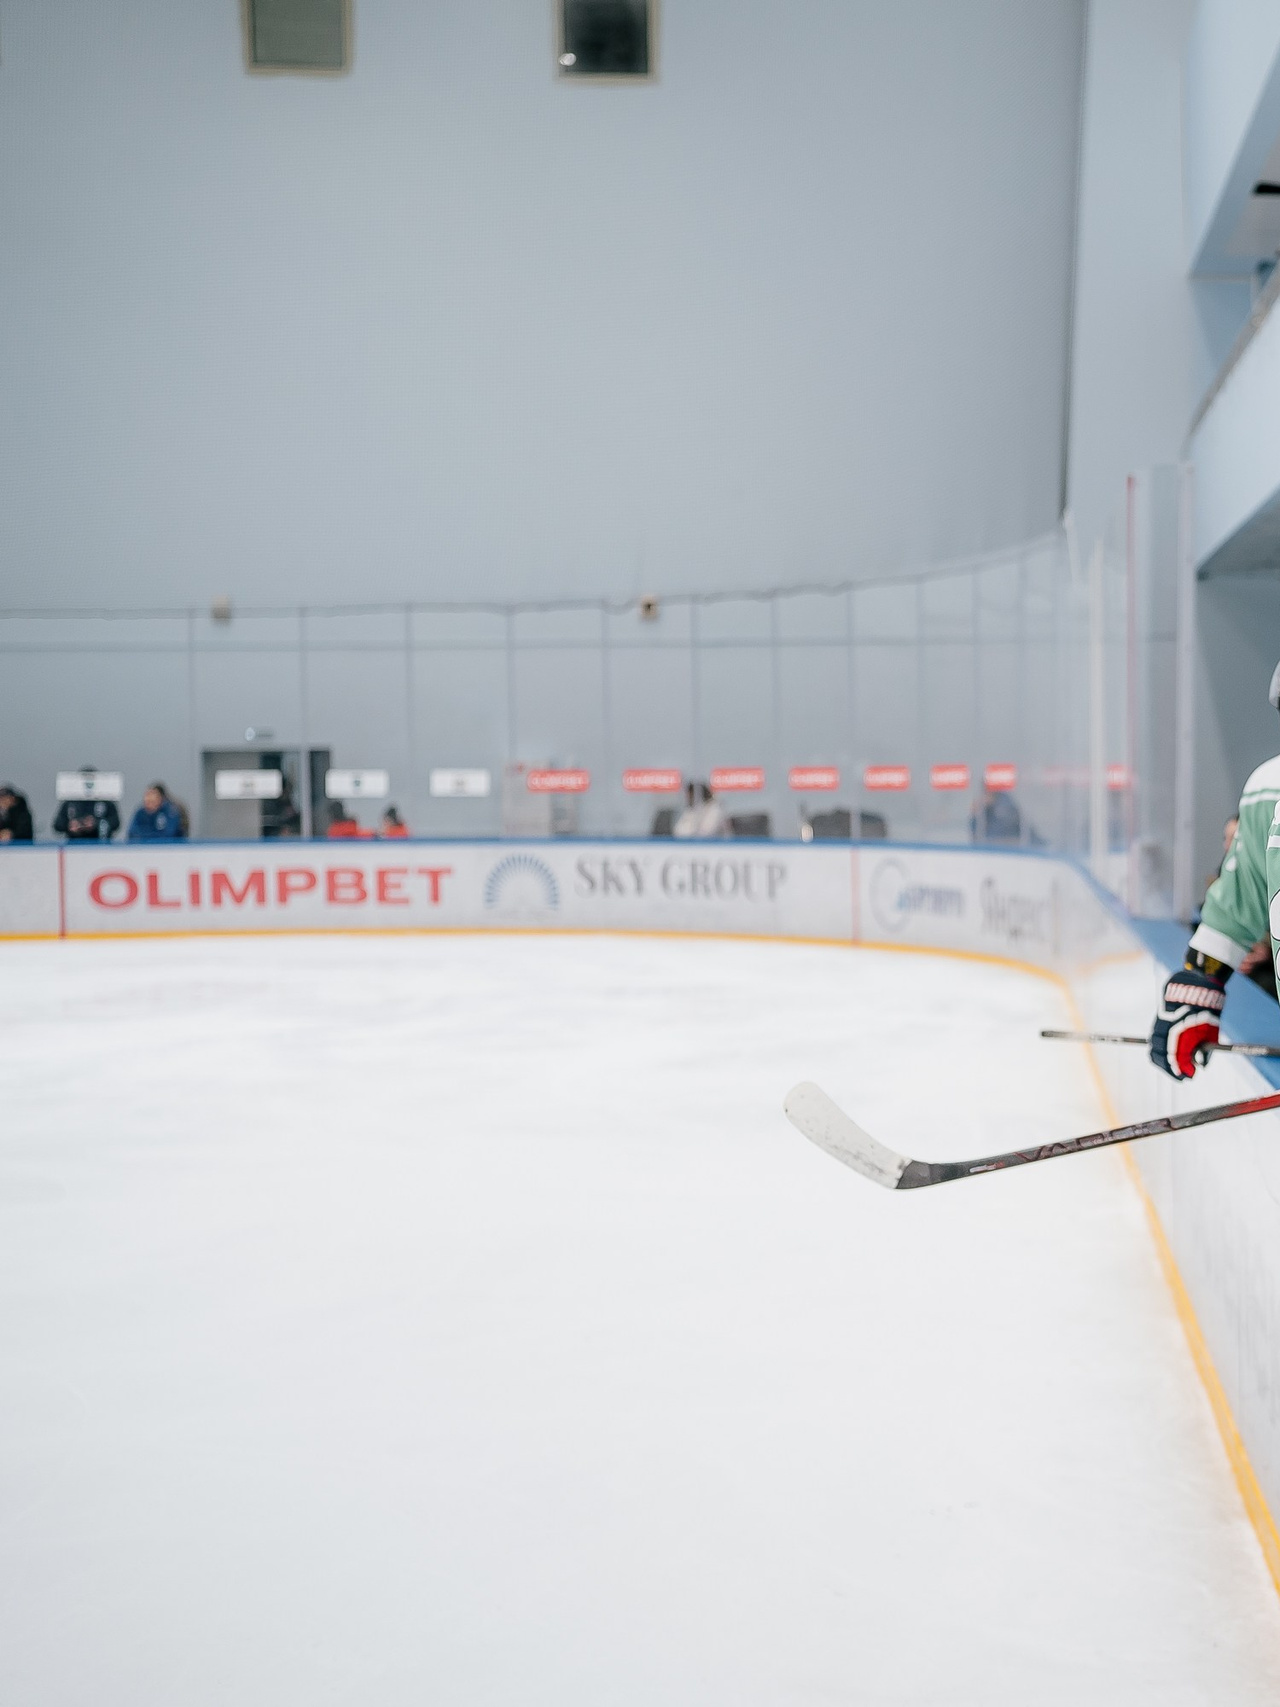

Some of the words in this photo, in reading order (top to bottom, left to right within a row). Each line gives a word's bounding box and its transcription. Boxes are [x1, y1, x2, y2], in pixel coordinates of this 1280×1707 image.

[88, 866, 453, 910] OLIMPBET
[575, 853, 649, 899] SKY
[660, 856, 789, 901] GROUP
